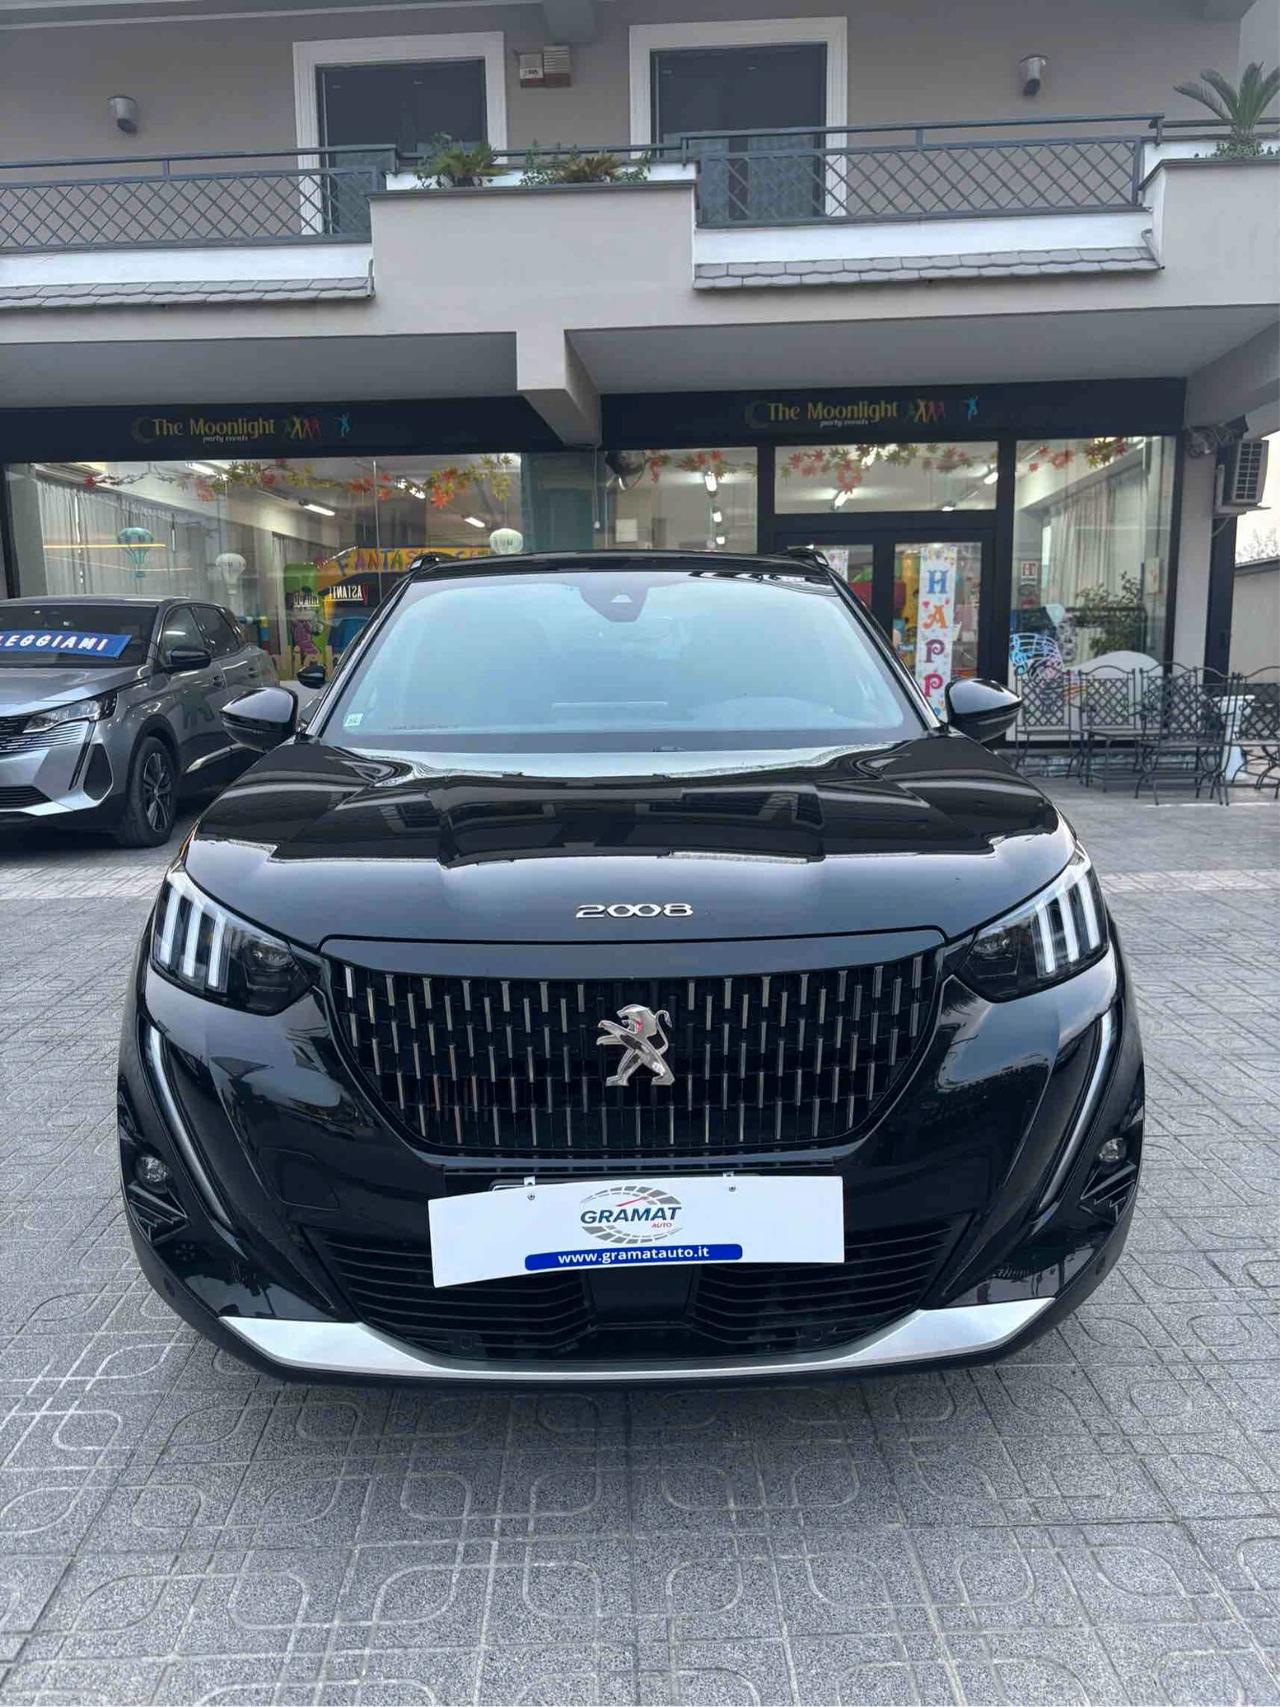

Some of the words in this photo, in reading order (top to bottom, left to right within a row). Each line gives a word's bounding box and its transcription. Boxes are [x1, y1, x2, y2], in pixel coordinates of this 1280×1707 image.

[767, 402, 800, 421] The
[807, 399, 898, 423] Moonlight
[152, 418, 183, 436] The
[190, 418, 275, 439] Moonlight
[336, 547, 420, 576] FANTAS
[576, 903, 693, 918] 2008
[580, 1207, 682, 1224] GRAMAT
[558, 1246, 710, 1264] www.gramatauto.it
